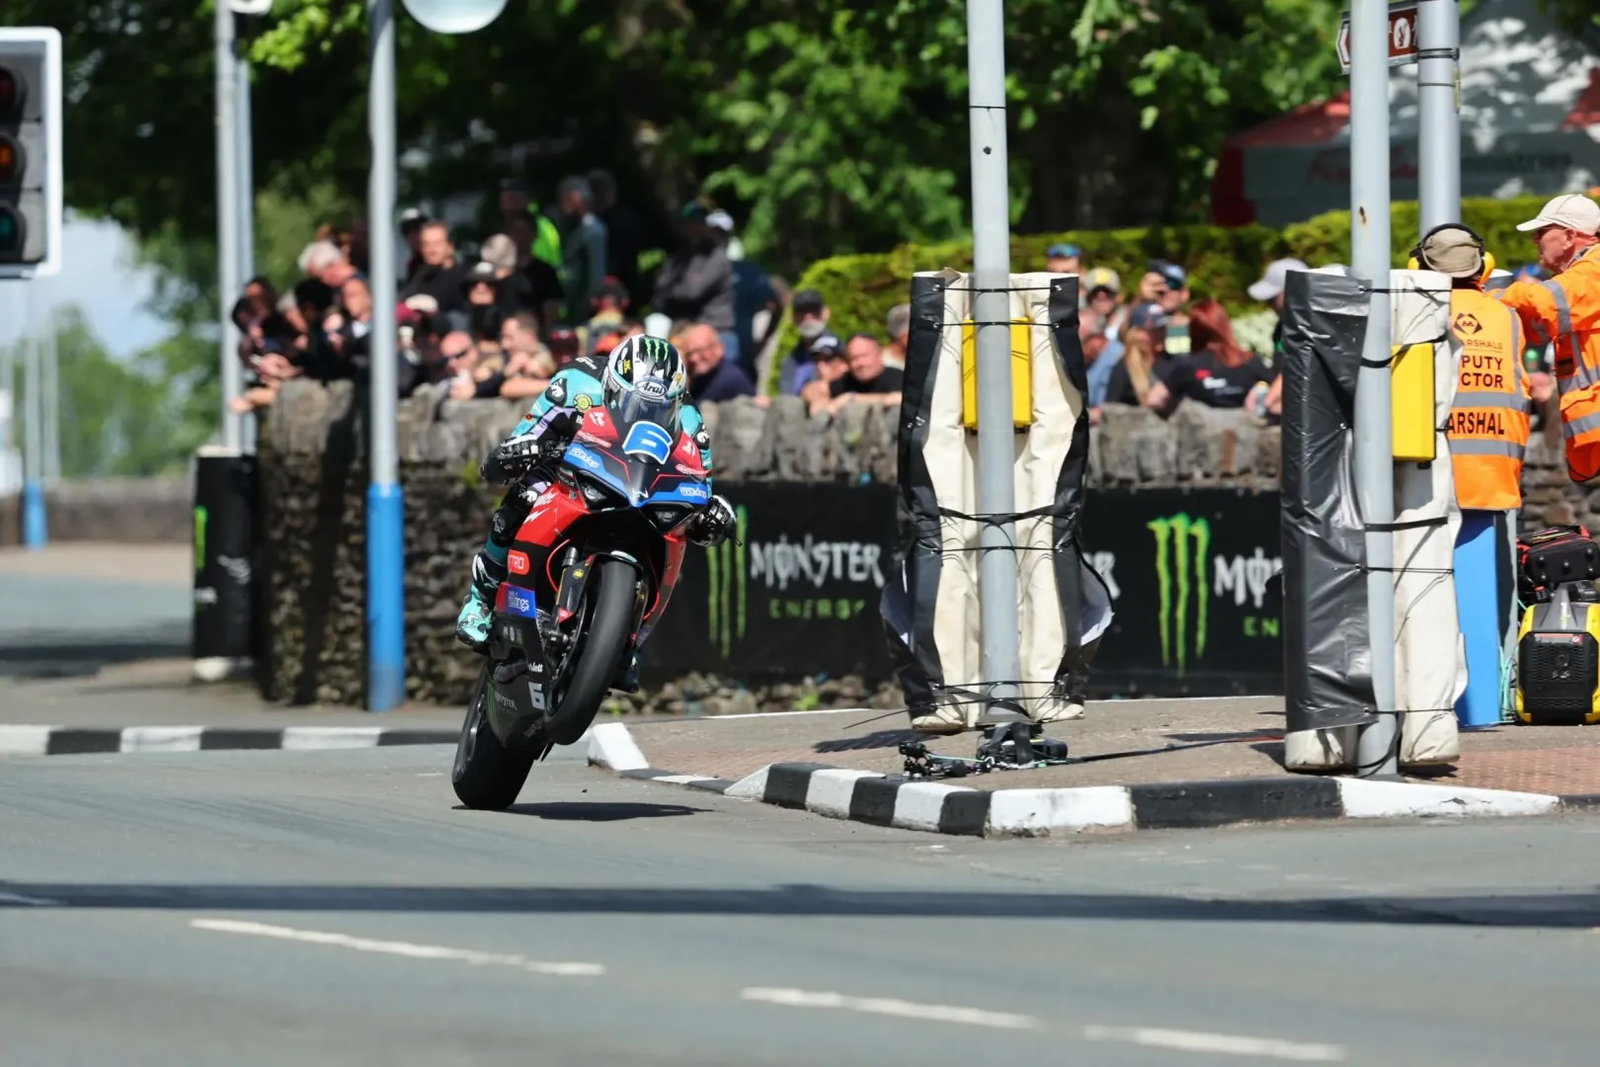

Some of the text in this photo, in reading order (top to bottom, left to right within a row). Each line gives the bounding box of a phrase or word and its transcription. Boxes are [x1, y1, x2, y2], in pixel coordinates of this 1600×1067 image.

[1466, 339, 1503, 349] RSHALS
[1461, 355, 1503, 370] PUTY
[642, 382, 665, 394] Arai
[1461, 373, 1504, 389] CTOR
[1447, 412, 1505, 435] ARSHAL
[750, 533, 885, 590] MONSTER
[528, 681, 546, 710] 6
